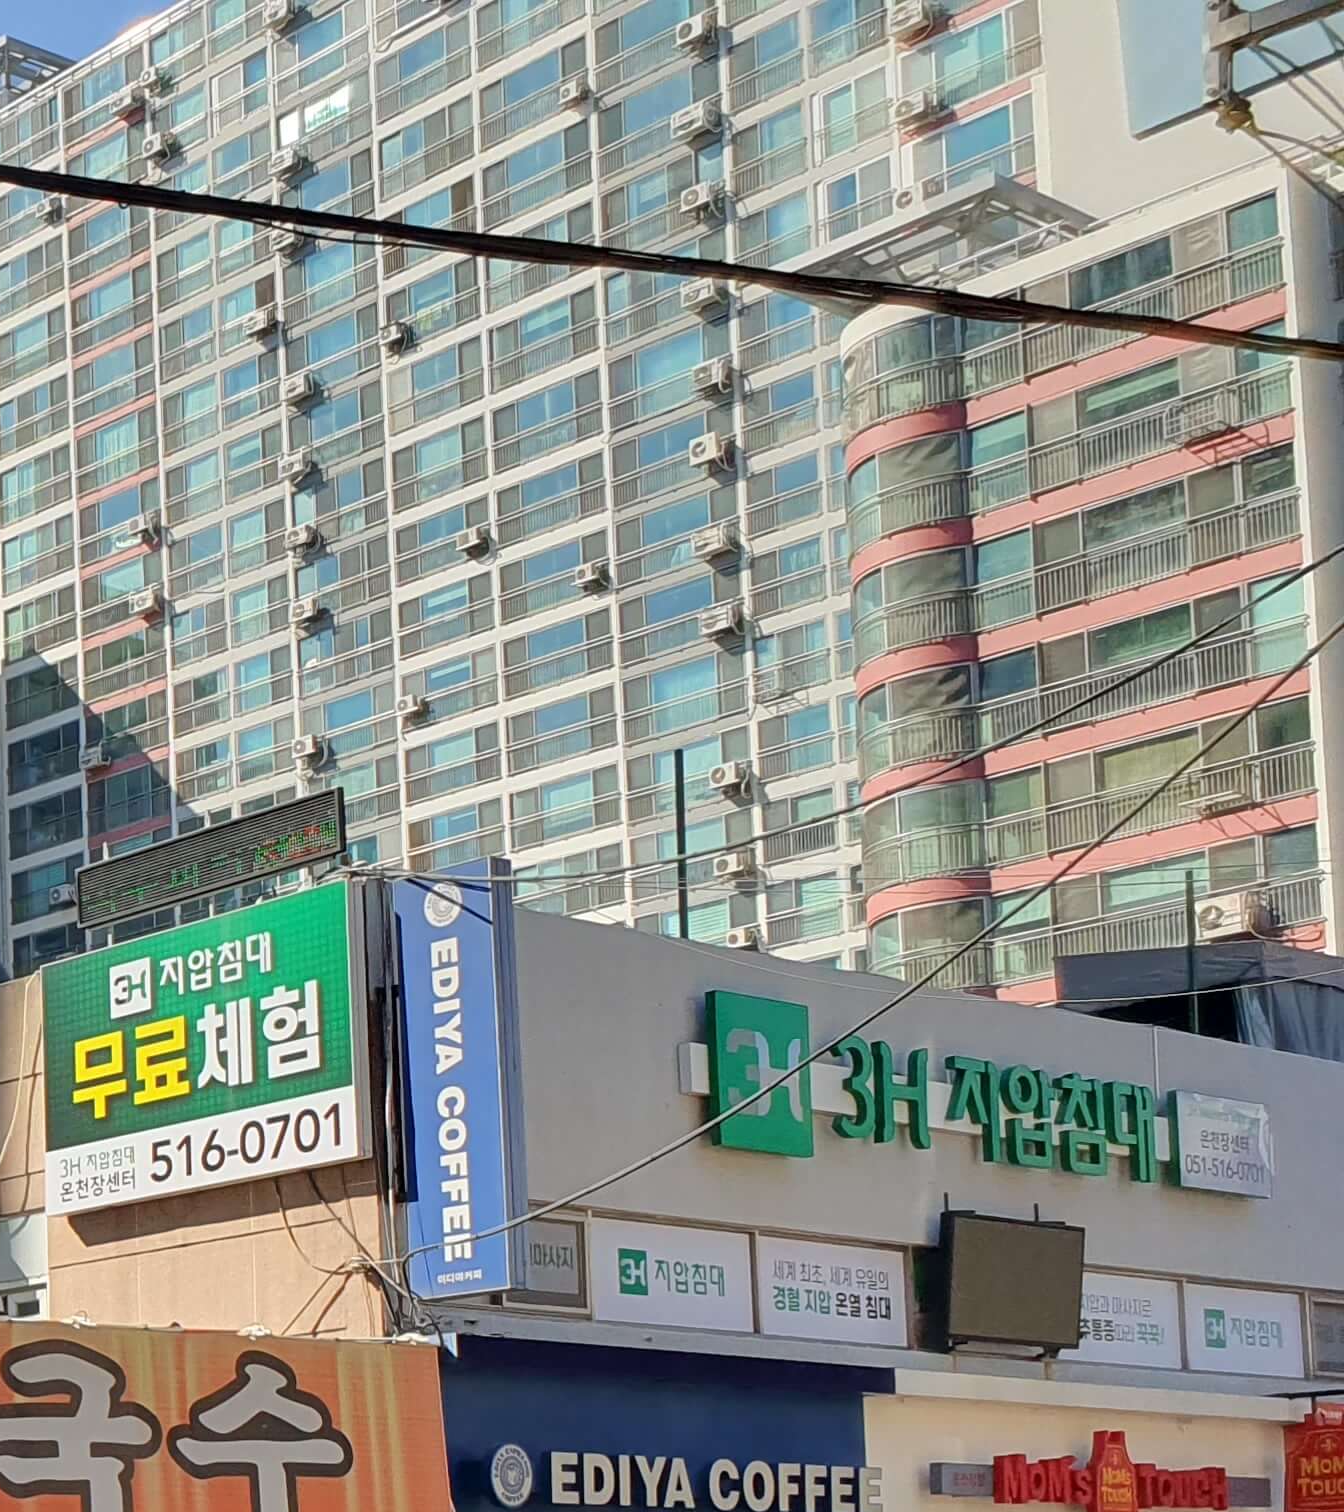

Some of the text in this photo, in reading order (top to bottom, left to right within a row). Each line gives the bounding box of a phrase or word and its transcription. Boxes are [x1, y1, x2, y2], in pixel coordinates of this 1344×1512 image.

[159, 932, 273, 996] 지압침대
[429, 936, 464, 1076] EDIYA
[73, 979, 321, 1120] 무료체험
[831, 1035, 930, 1150] 3H
[945, 1055, 1158, 1184] 지압침대
[60, 1145, 136, 1178] 3H 지압침대
[150, 1102, 343, 1184] 516-0701
[60, 1168, 137, 1203] 온천장센터
[436, 1085, 474, 1264] COFFEE
[1184, 1153, 1266, 1185] 051-516-0701
[528, 1242, 574, 1271] 마사지
[772, 1259, 796, 1282] 세계
[829, 1265, 852, 1286] 세계
[855, 1267, 890, 1292] 유일의
[654, 1259, 725, 1297] 지압침대
[771, 1285, 892, 1321] 경혈 지압 온열 침대
[1229, 1316, 1284, 1349] 지압침대
[550, 1451, 696, 1509] EDIYA
